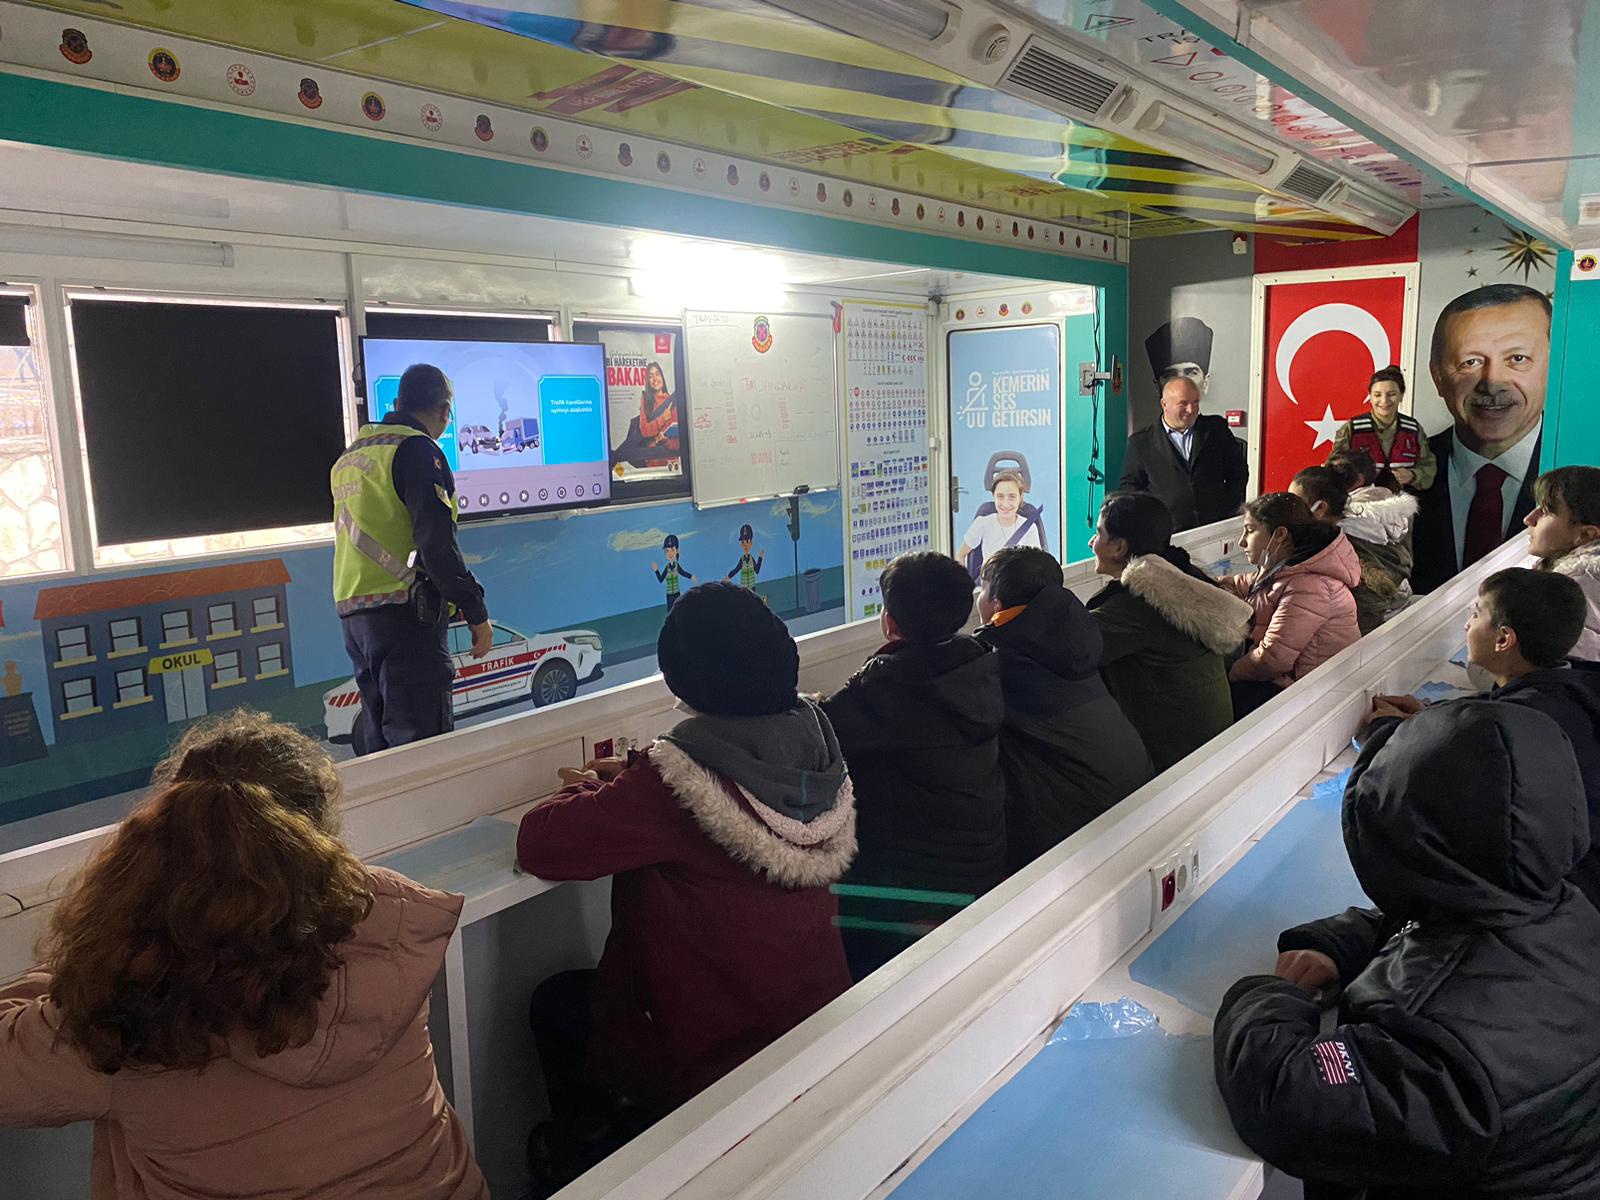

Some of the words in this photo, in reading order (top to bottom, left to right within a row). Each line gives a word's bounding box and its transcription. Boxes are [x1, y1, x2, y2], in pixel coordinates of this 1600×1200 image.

[992, 392, 1017, 410] SES
[162, 653, 201, 670] OKUL
[481, 656, 514, 672] TRAFİK
[1335, 1041, 1358, 1080] DKNY
